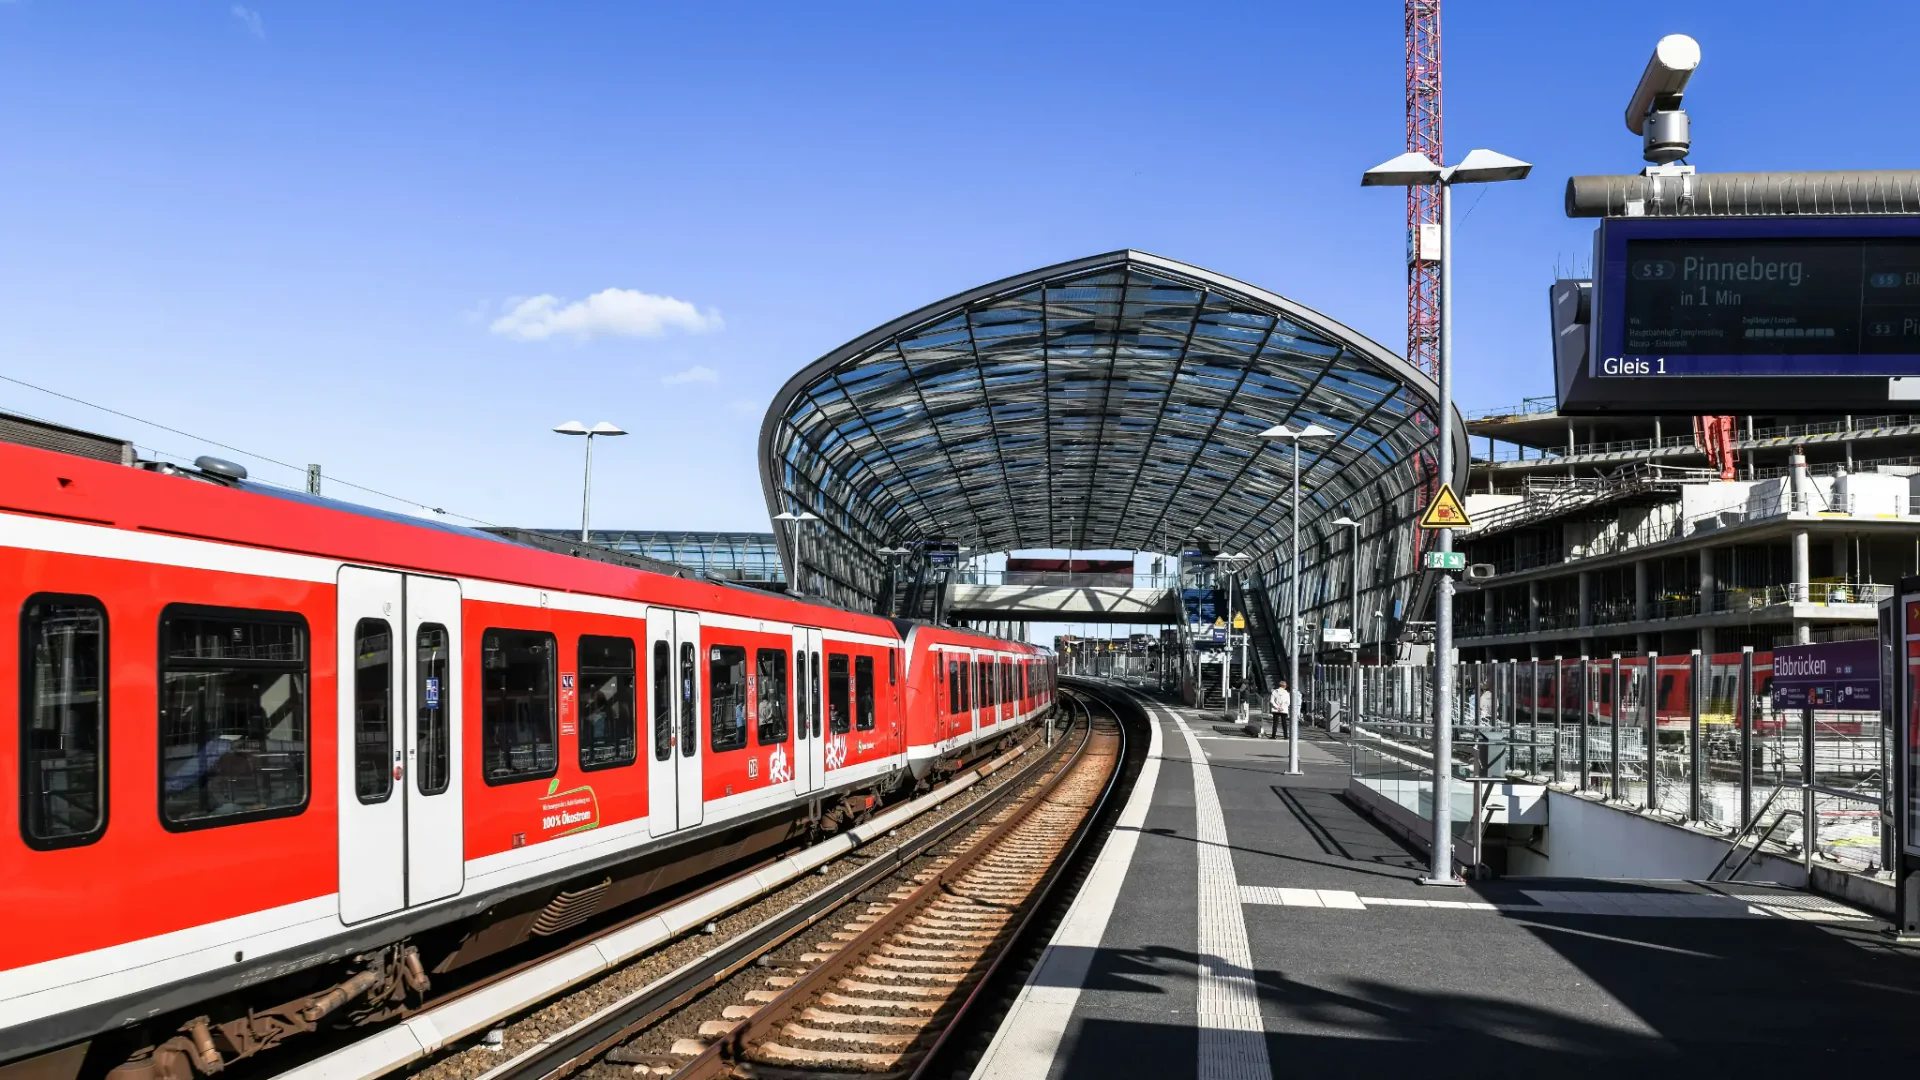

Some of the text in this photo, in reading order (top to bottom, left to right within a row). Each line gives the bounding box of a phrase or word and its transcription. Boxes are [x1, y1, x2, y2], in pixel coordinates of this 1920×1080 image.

[1683, 256, 1803, 286] Pinneberg
[1680, 286, 1741, 306] in 1 Min
[1903, 318, 1920, 336] Pi
[1603, 357, 1667, 375] Gleis 1
[1774, 654, 1827, 676] Elbbrücken
[749, 759, 758, 777] DB
[561, 810, 591, 825] Ökostrom
